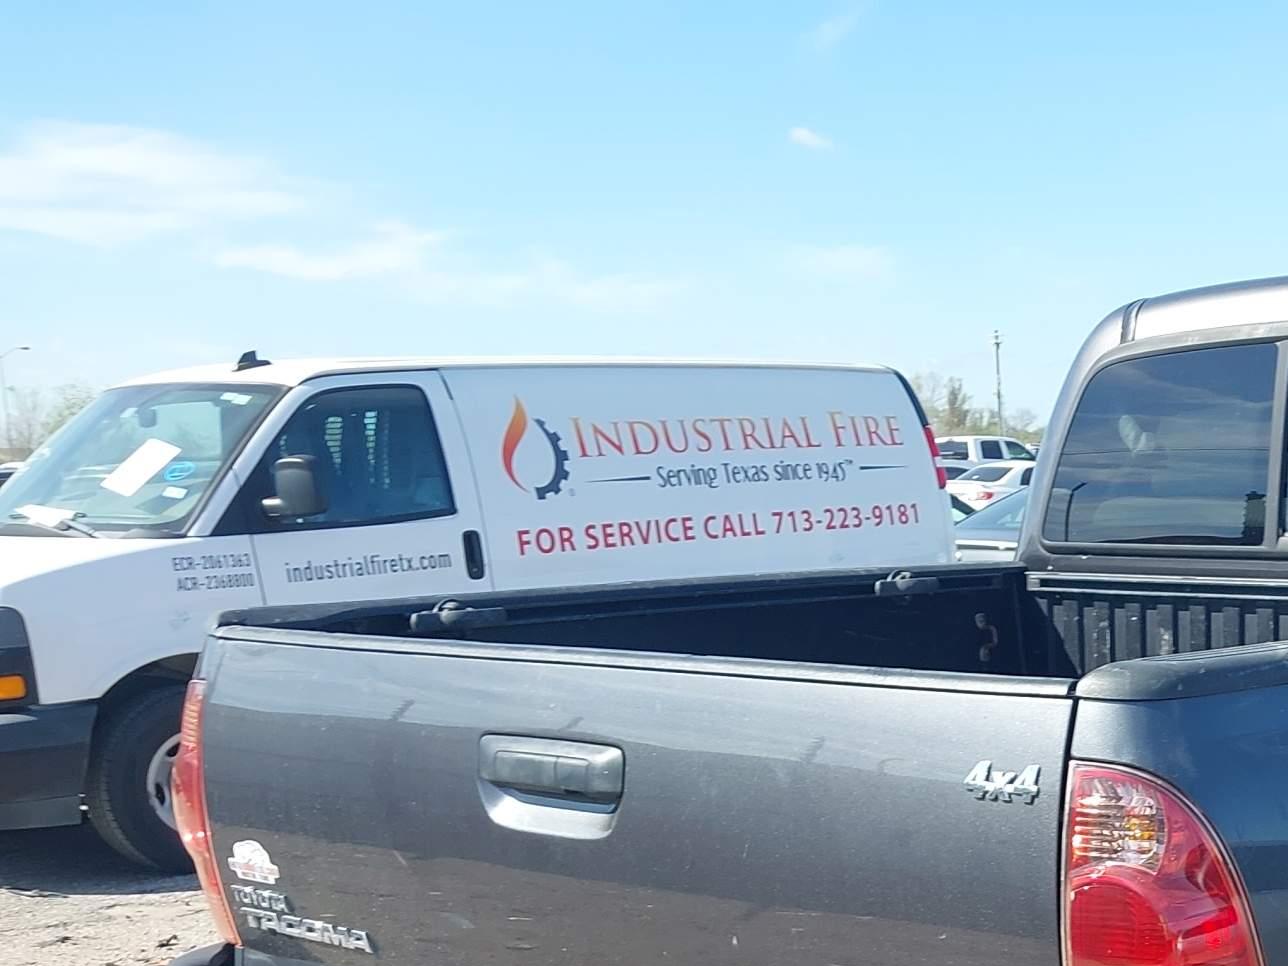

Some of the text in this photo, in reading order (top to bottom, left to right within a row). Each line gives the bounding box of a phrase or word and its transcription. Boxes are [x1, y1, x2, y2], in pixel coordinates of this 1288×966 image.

[570, 411, 904, 459] INDUSTRIAL FIRE
[656, 465, 719, 488] Serving
[721, 461, 769, 484] Texas
[774, 460, 812, 482] since
[517, 503, 920, 556] FOR SERVICE CALL 713-223-9181
[285, 552, 452, 583] industrialfiretx.com
[240, 906, 373, 954] TACOMA
